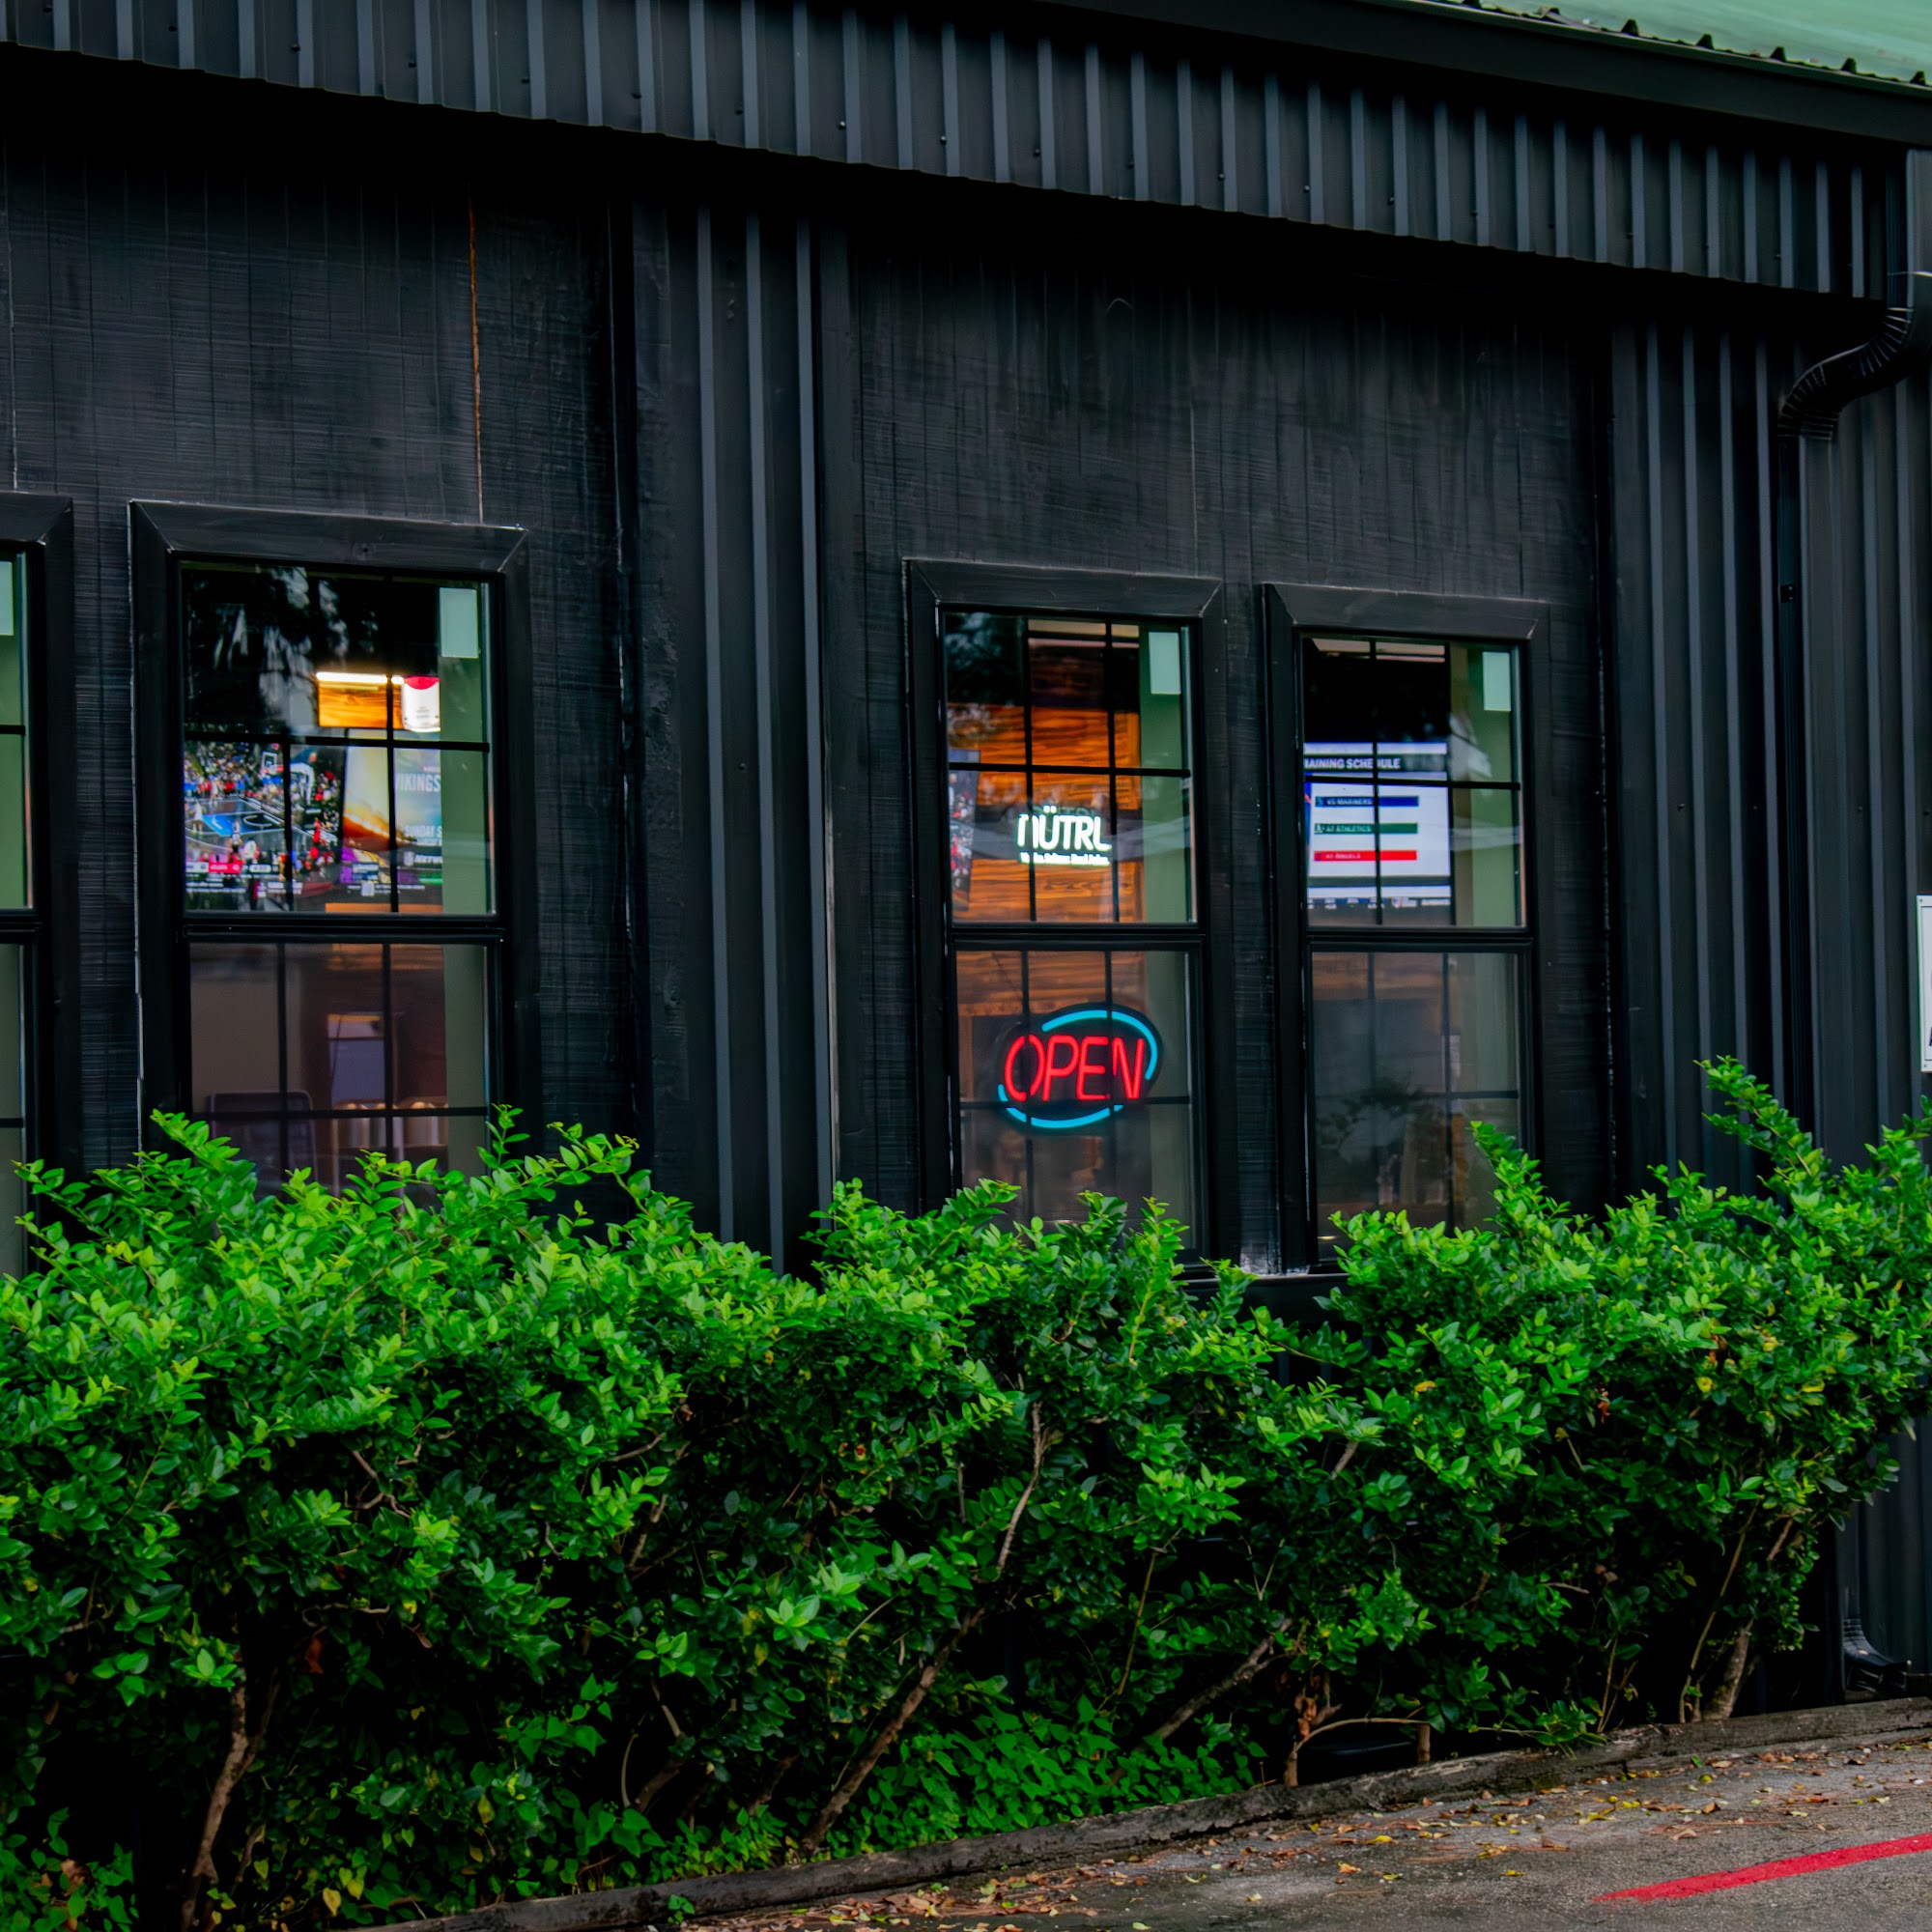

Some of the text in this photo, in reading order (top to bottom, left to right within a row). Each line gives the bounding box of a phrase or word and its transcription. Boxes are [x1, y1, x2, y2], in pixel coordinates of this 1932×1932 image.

[1346, 757, 1401, 769] SCHEULE
[395, 773, 440, 792] VIKINGS
[1005, 1034, 1145, 1102] OPEN
